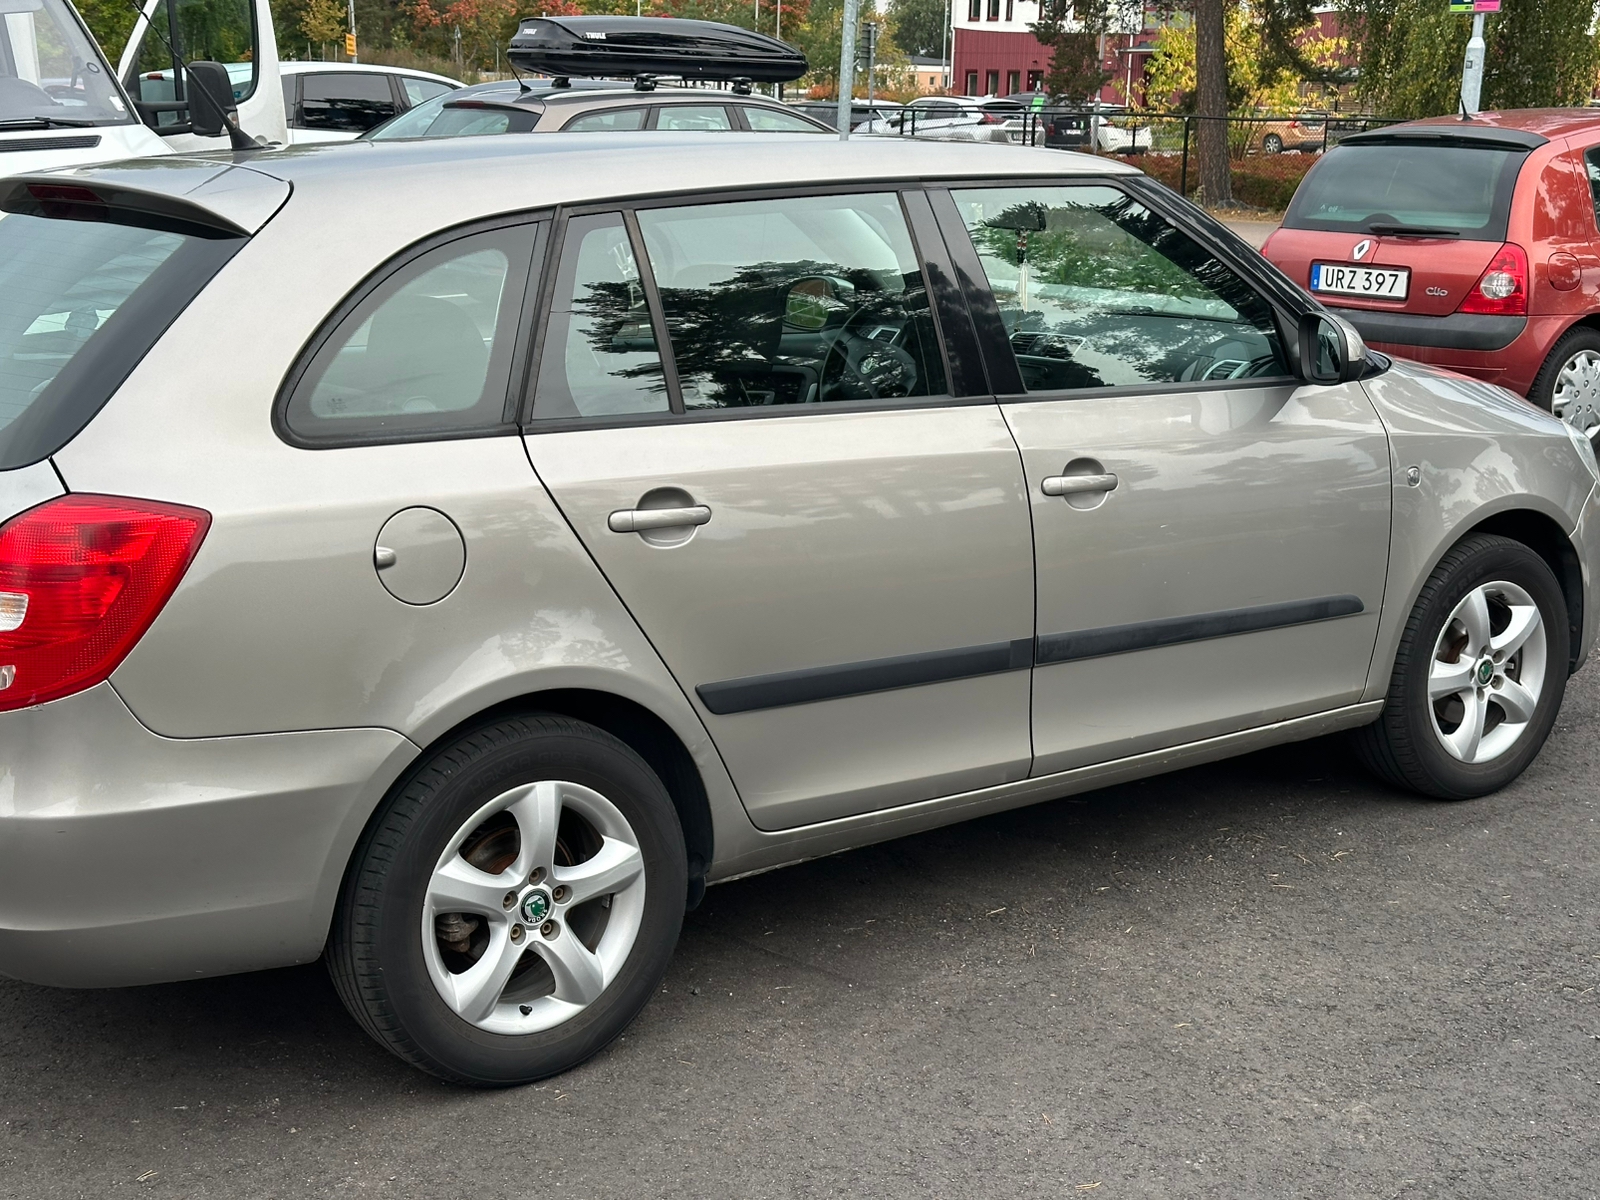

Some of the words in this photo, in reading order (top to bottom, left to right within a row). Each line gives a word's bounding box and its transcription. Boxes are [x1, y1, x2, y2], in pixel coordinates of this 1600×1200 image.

[1325, 268, 1356, 290] URZ
[1362, 271, 1399, 293] 397
[468, 753, 532, 795] HAKKA
